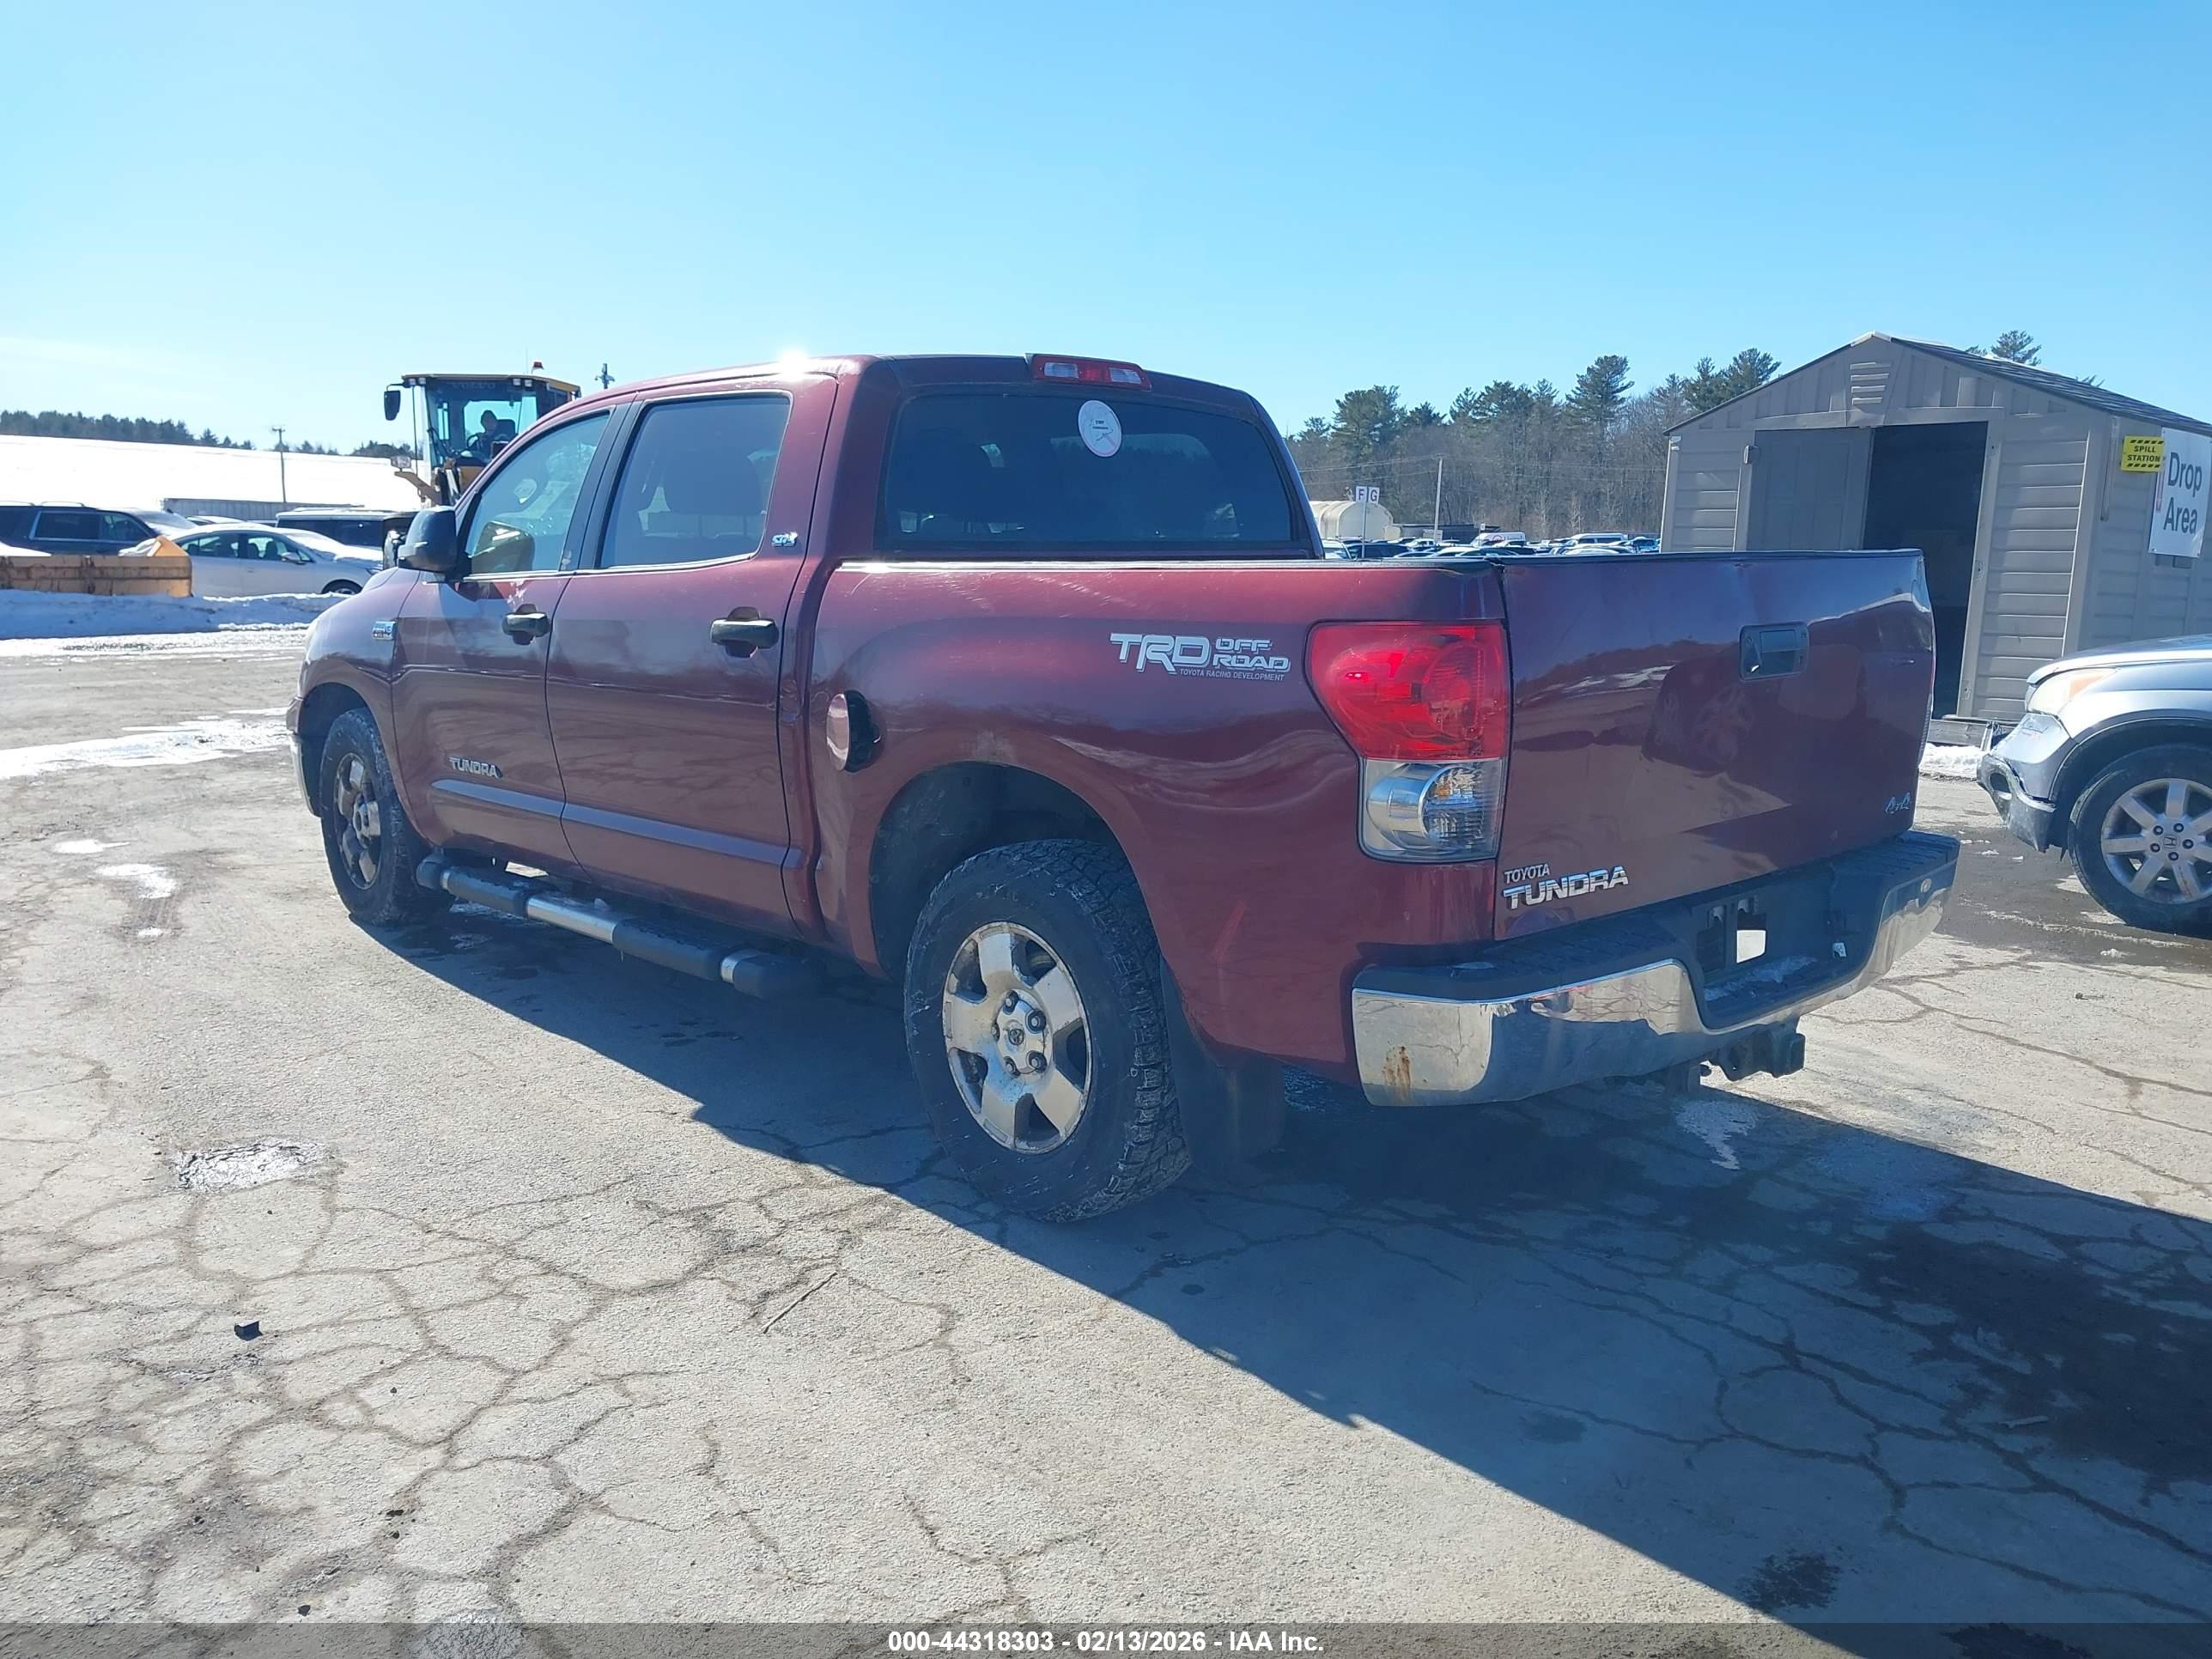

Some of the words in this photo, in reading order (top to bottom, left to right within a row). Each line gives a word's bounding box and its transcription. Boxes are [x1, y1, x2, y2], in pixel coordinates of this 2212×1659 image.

[2167, 452, 2203, 497] Drop
[1358, 489, 1365, 501] F
[1370, 489, 1378, 501] G
[2163, 497, 2198, 534] Area
[1110, 633, 1211, 674] TRD
[1215, 638, 1273, 653] OFF
[1212, 653, 1291, 672] ROAD
[1180, 668, 1204, 677] TOYOTA
[1233, 672, 1285, 681] DEVELOPMENT
[449, 757, 499, 778] TUNDRA
[1504, 864, 1551, 884] TOYOTA
[1503, 866, 1629, 909] TUNDRA
